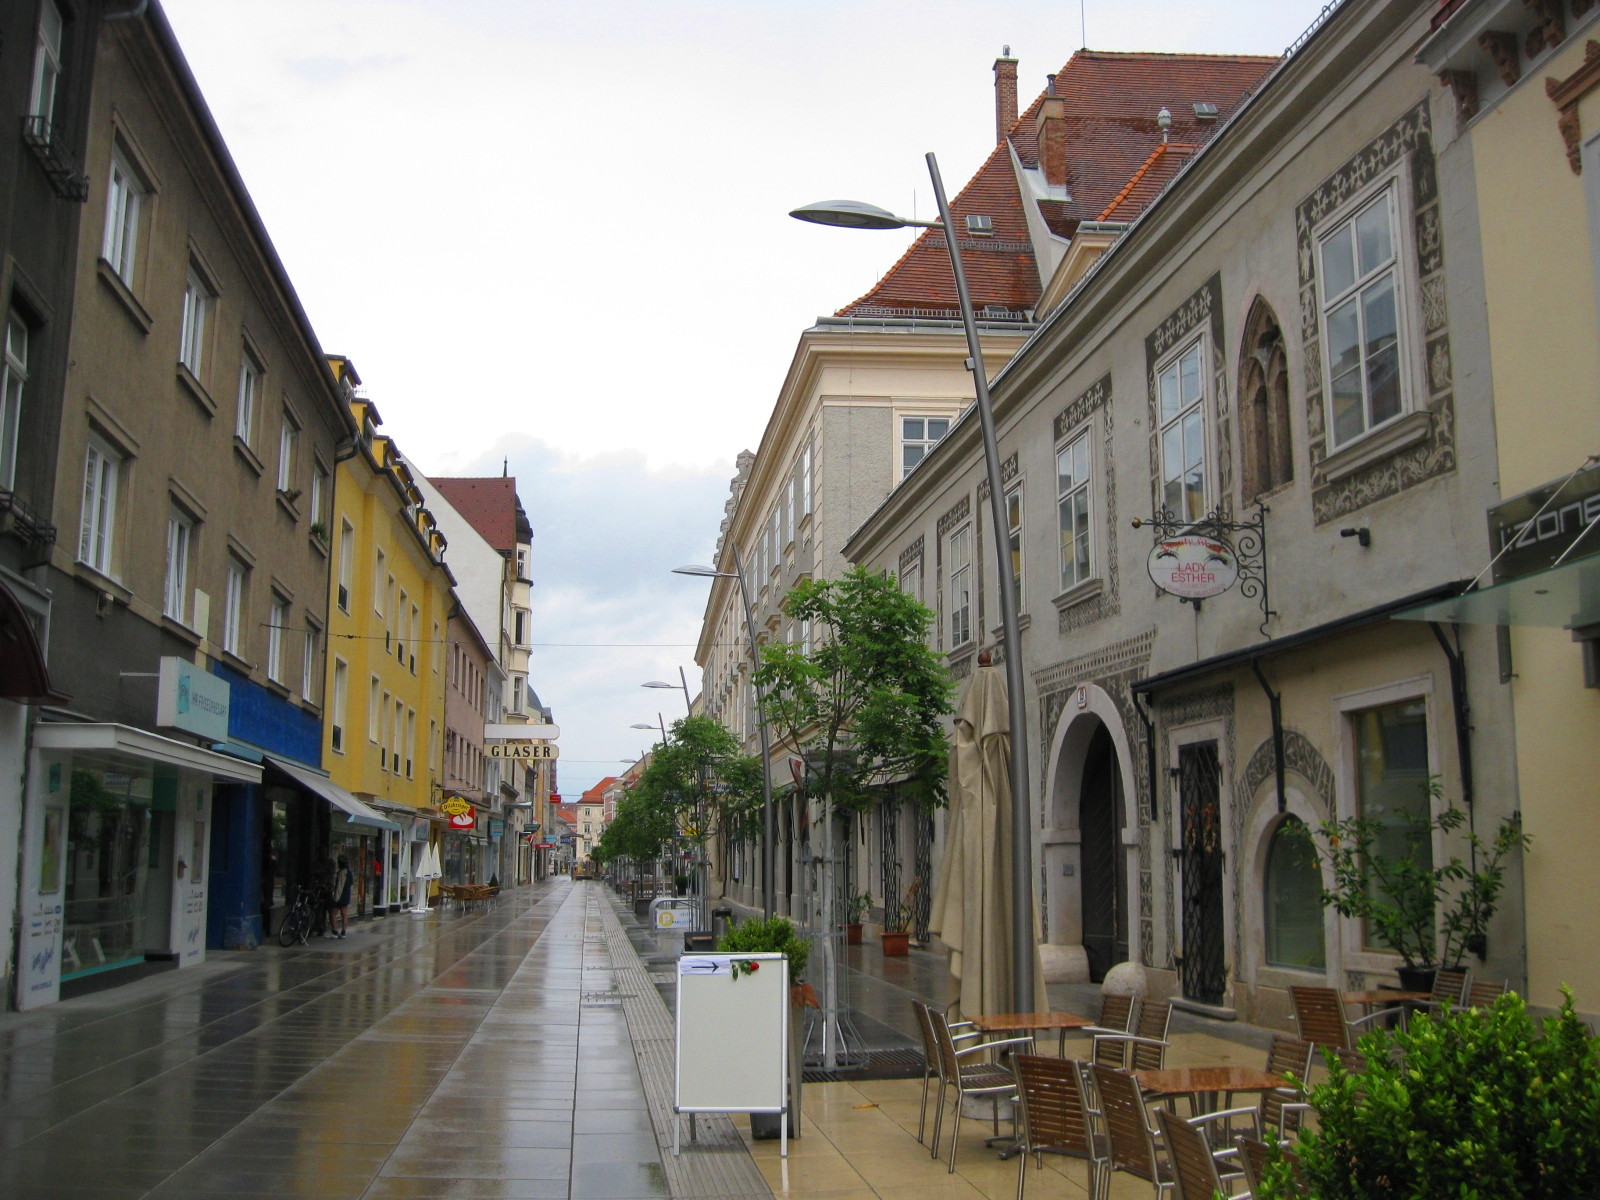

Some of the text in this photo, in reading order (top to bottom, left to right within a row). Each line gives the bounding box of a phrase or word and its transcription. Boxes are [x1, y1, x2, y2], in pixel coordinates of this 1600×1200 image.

[1178, 562, 1206, 572] LADY
[1171, 573, 1215, 583] ESTHER
[491, 745, 551, 758] GLASER
